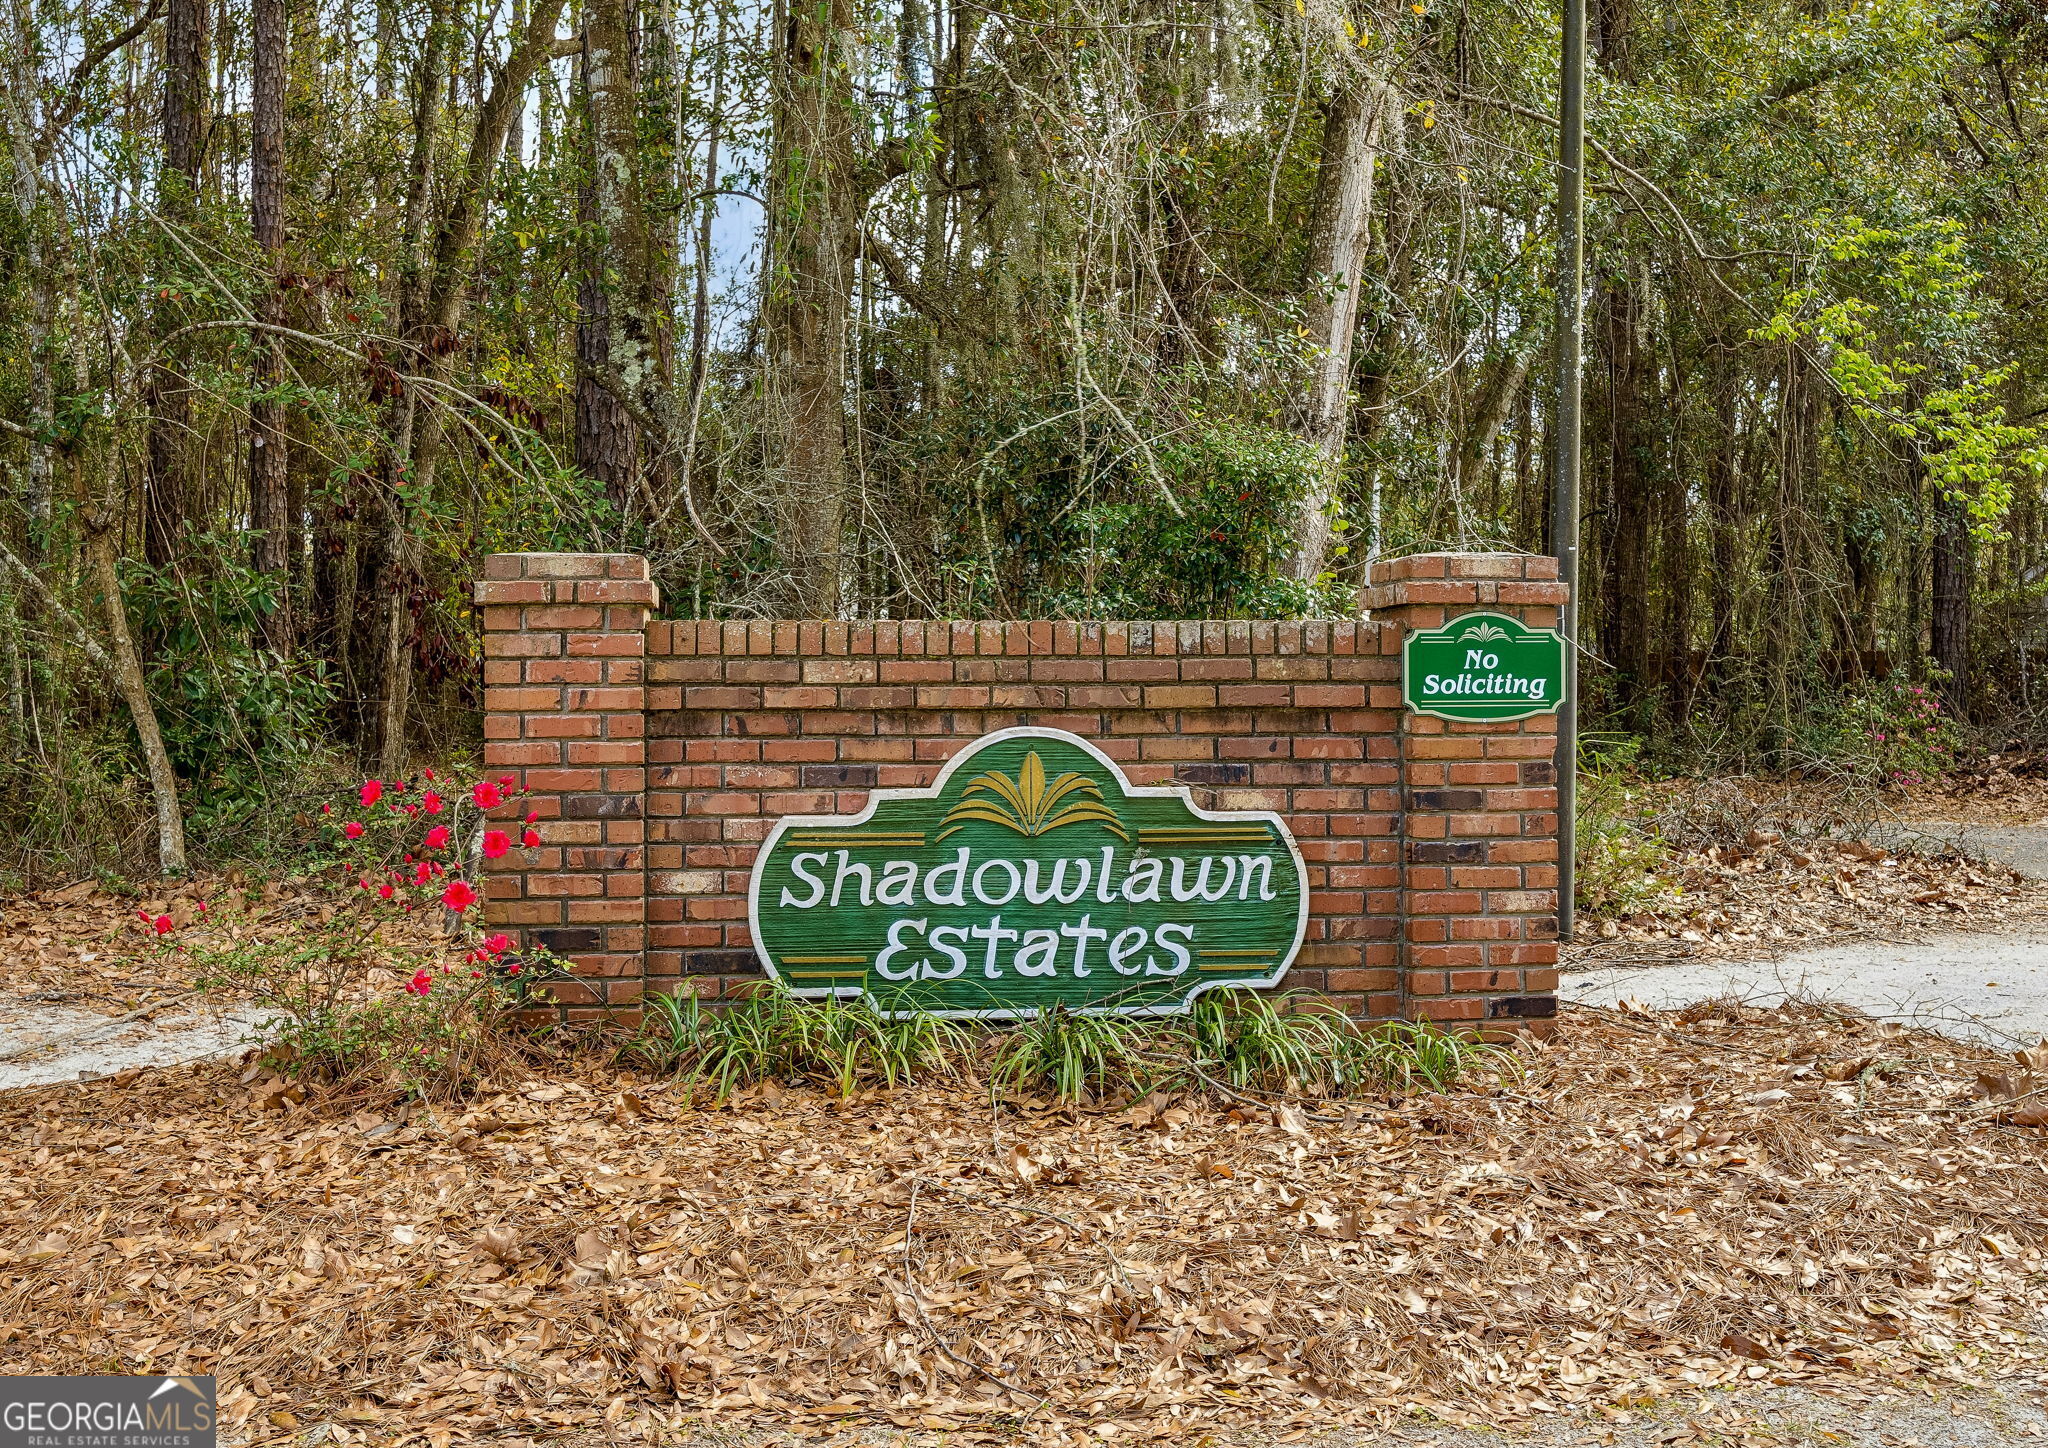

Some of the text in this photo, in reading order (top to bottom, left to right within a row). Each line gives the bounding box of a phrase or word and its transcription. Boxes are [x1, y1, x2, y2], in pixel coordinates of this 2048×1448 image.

[1464, 650, 1498, 669] No
[1423, 673, 1547, 699] Soliciting
[780, 846, 1277, 908] Shadowlawn
[875, 914, 1194, 980] Estates
